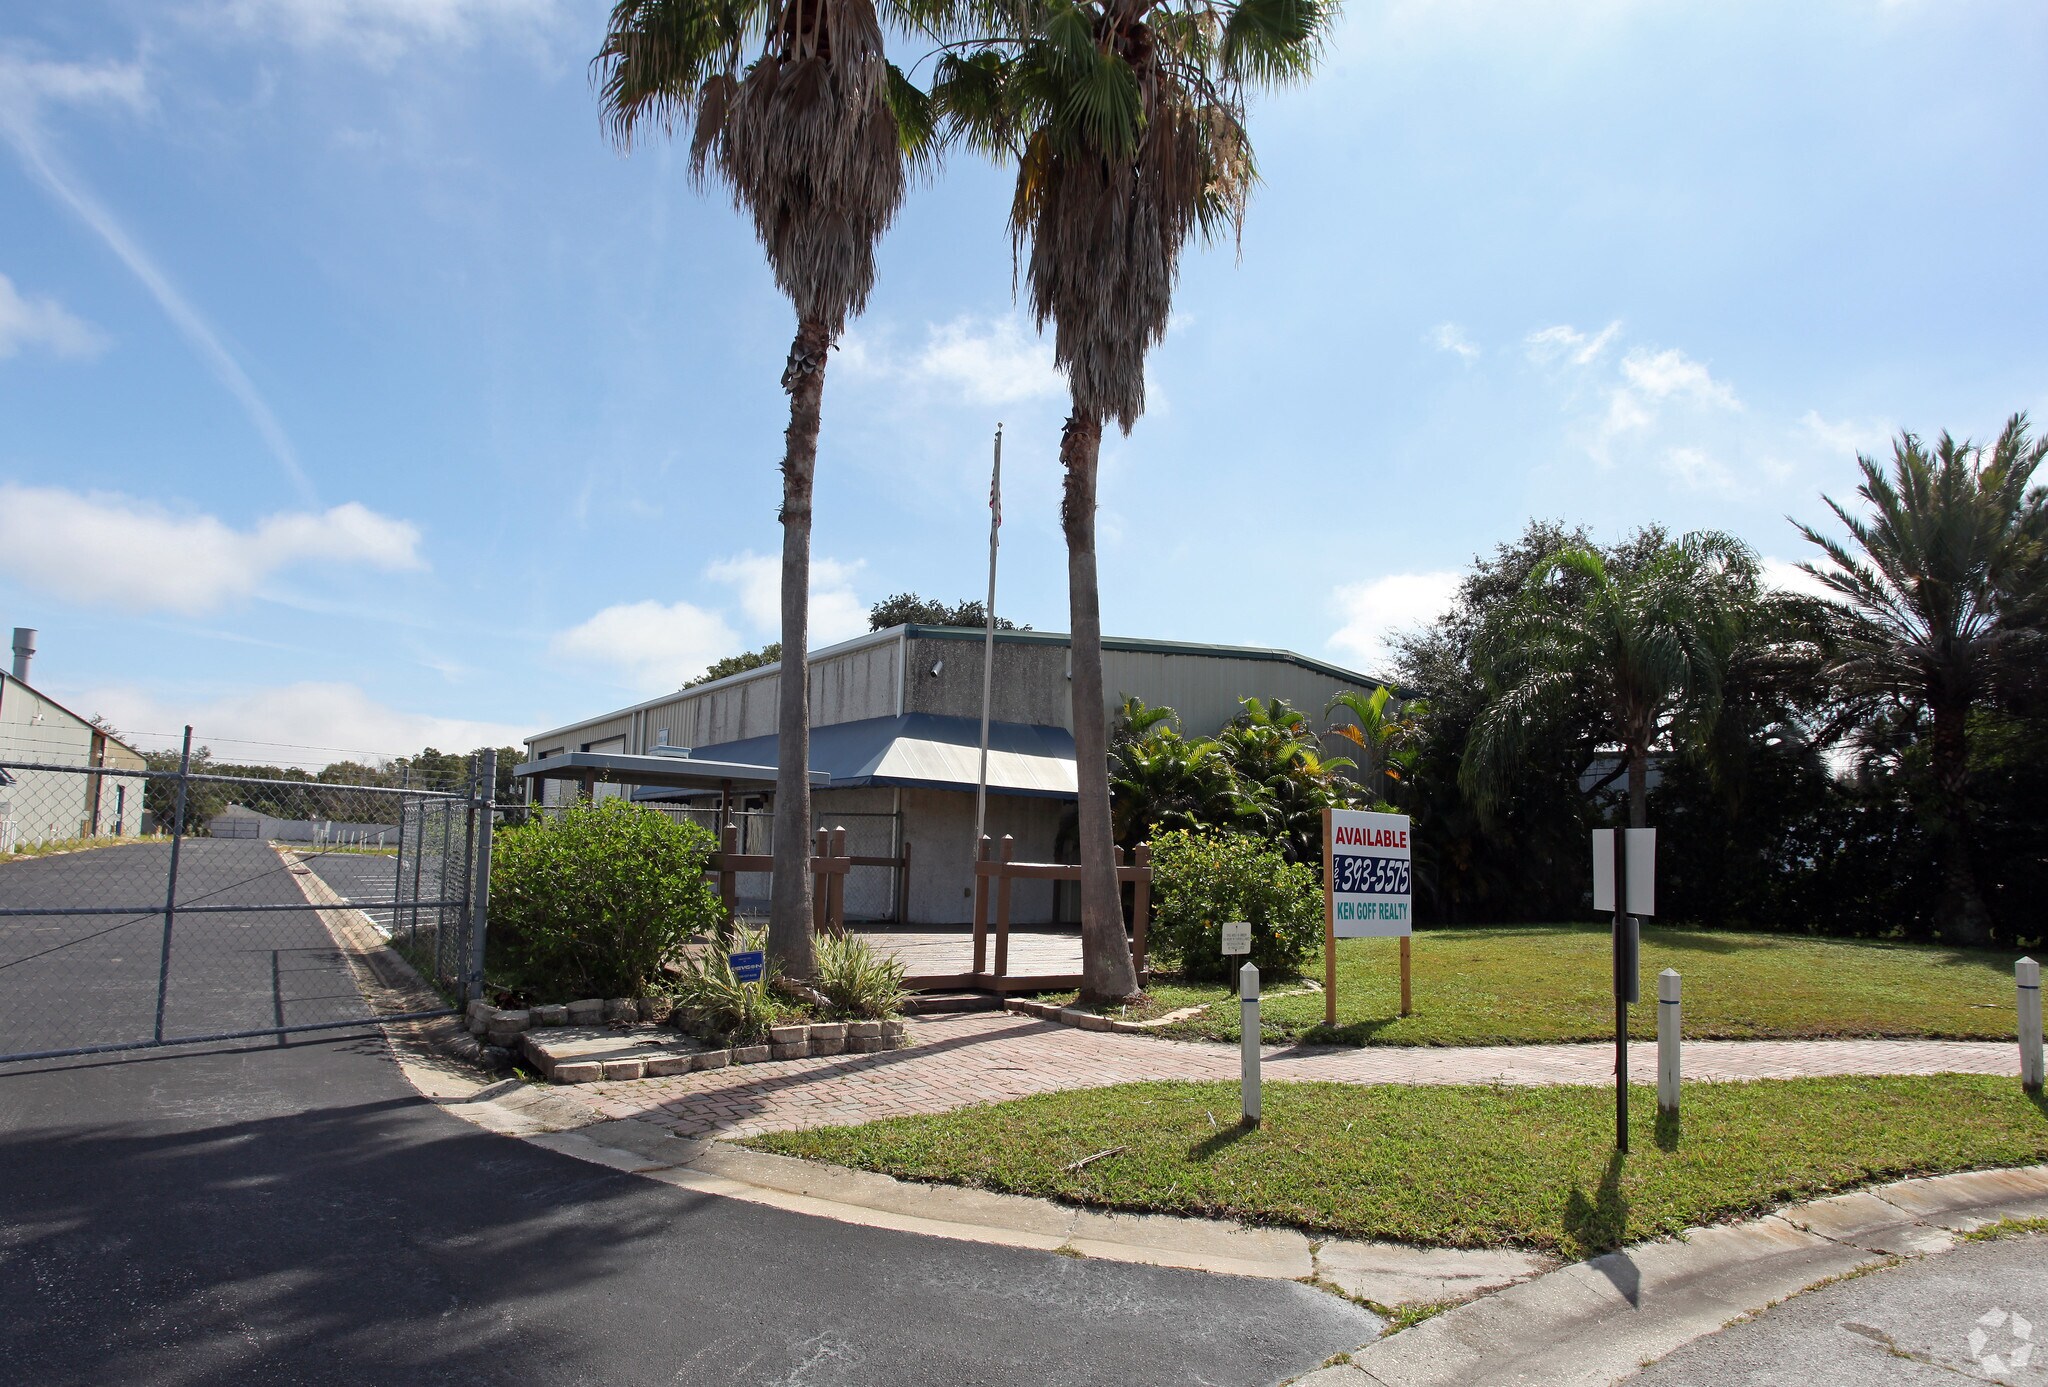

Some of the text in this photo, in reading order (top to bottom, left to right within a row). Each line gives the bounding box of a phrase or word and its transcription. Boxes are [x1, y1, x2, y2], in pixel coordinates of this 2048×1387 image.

[1335, 826, 1407, 849] AVAILABLE
[1342, 857, 1409, 893] 393-5575
[1337, 902, 1408, 920] KEN GOFF REALTY
